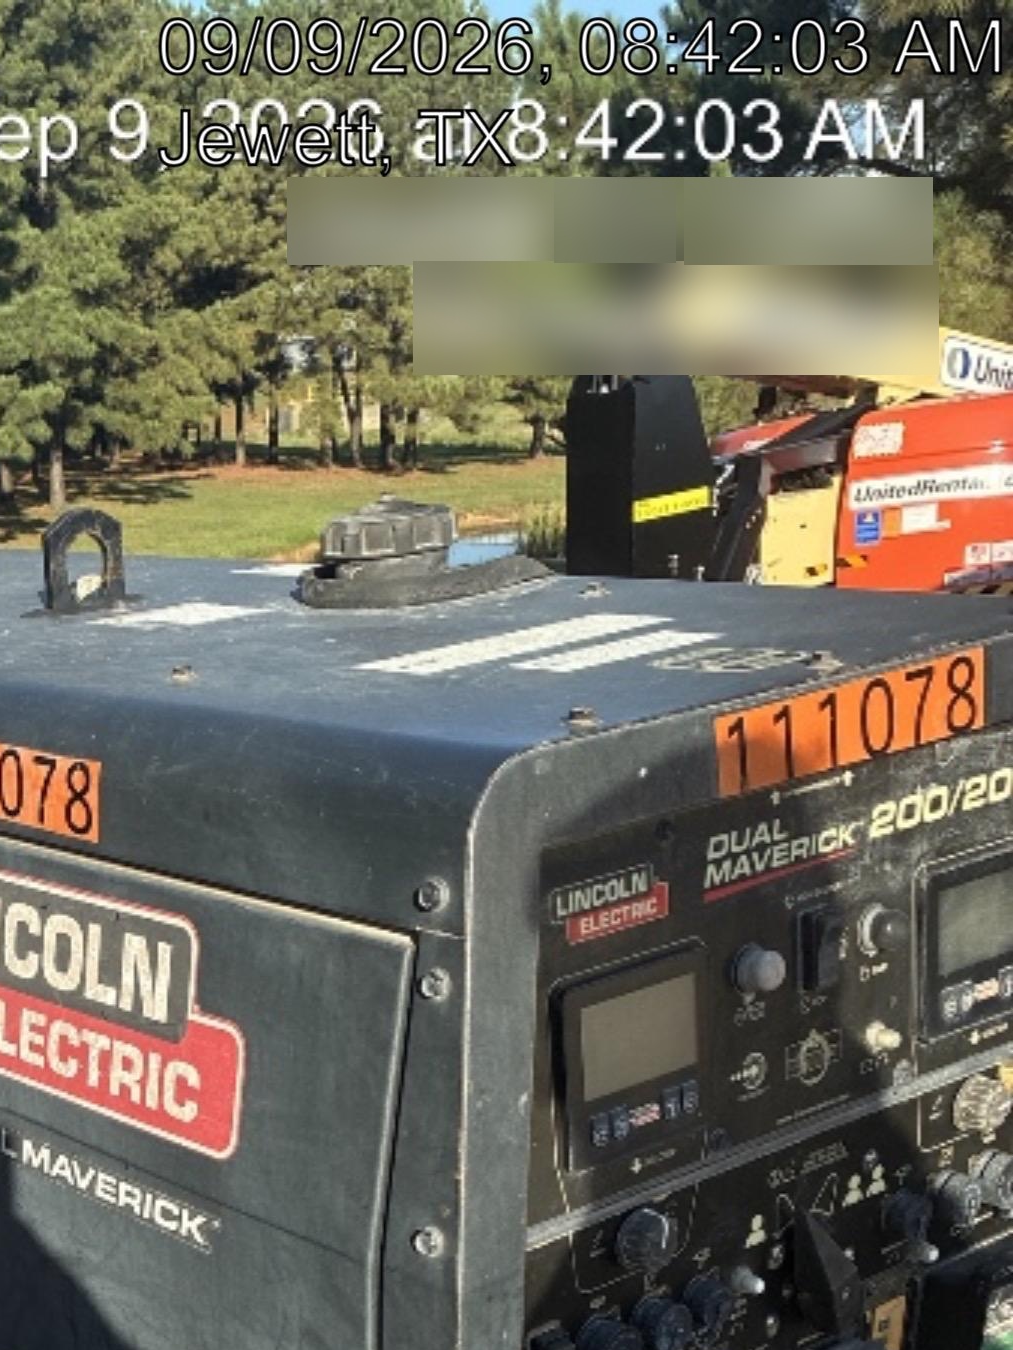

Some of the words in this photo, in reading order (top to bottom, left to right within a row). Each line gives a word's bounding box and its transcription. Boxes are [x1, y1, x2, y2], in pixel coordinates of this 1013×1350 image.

[727, 655, 977, 794] 111078
[703, 824, 864, 889] MAVERICK
[707, 818, 789, 860] DUAL
[556, 870, 649, 917] LINCOLN
[580, 896, 658, 935] ELECTRIC
[21, 1138, 212, 1245] MAVERICK
